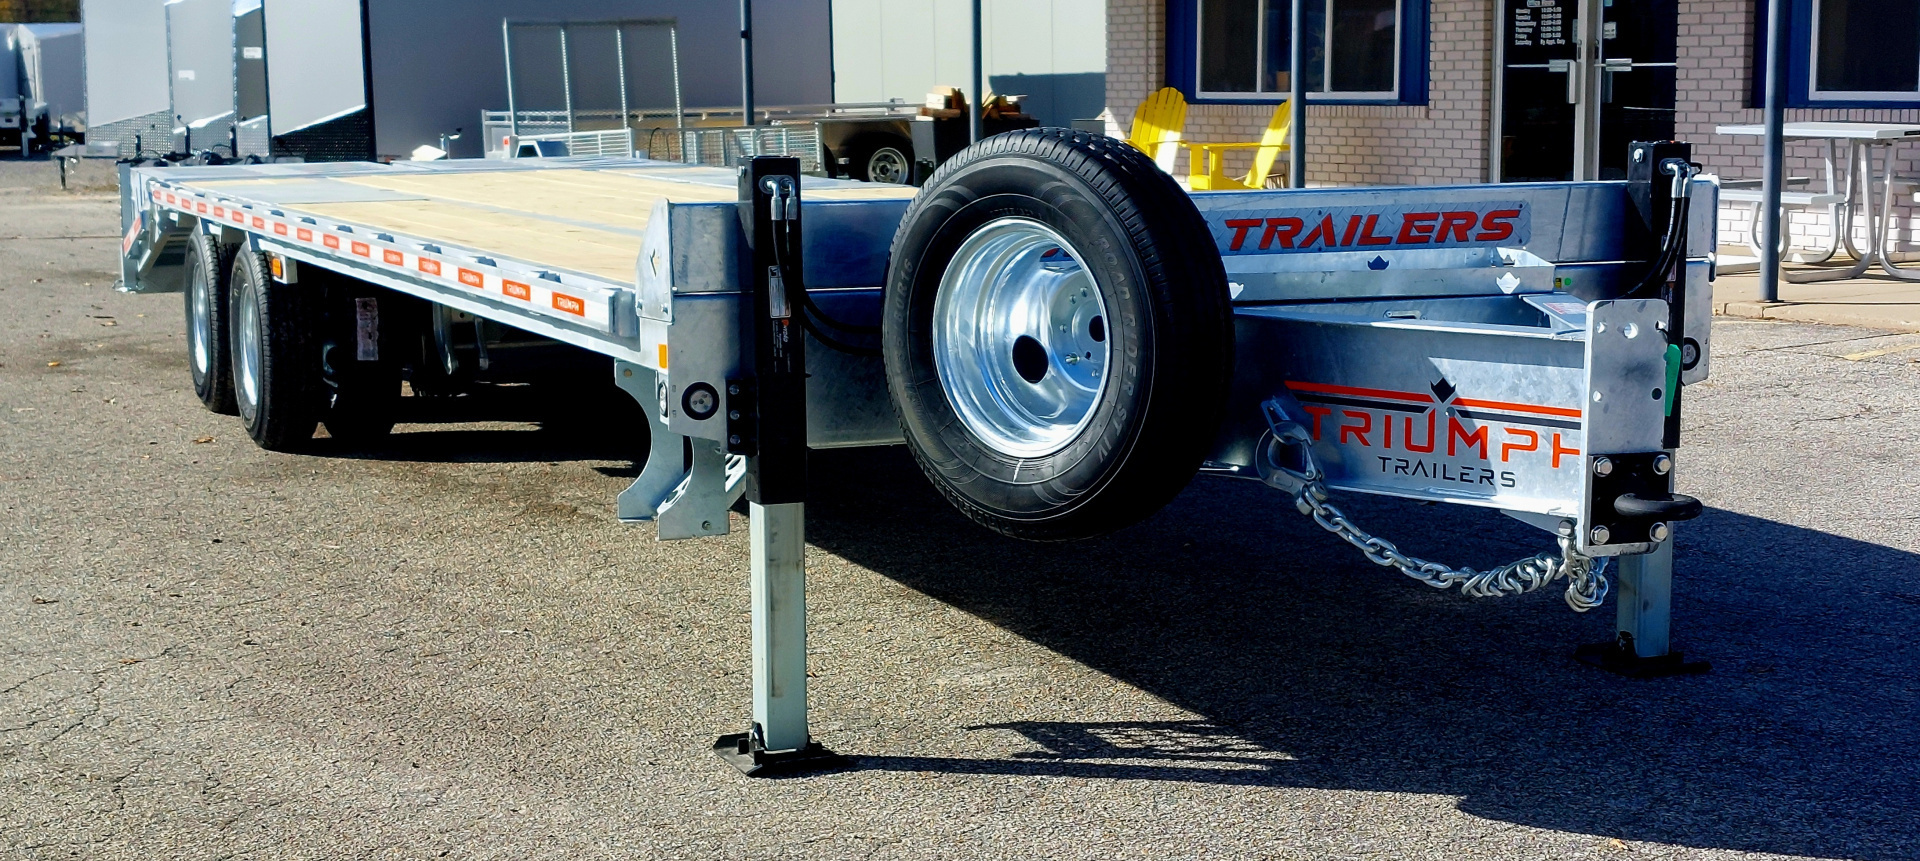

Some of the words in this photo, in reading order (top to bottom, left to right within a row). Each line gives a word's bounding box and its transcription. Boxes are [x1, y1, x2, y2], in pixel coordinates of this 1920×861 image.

[1224, 208, 1521, 251] TRAILERS
[1099, 236, 1131, 300] ROAD
[506, 283, 526, 297] TRIUMPH
[557, 296, 579, 311] TRIUMPH
[1123, 313, 1138, 397] RIDER
[1112, 402, 1127, 437] ST
[1302, 404, 1581, 468] TRIUMPH
[1377, 455, 1516, 488] TRAILERS
